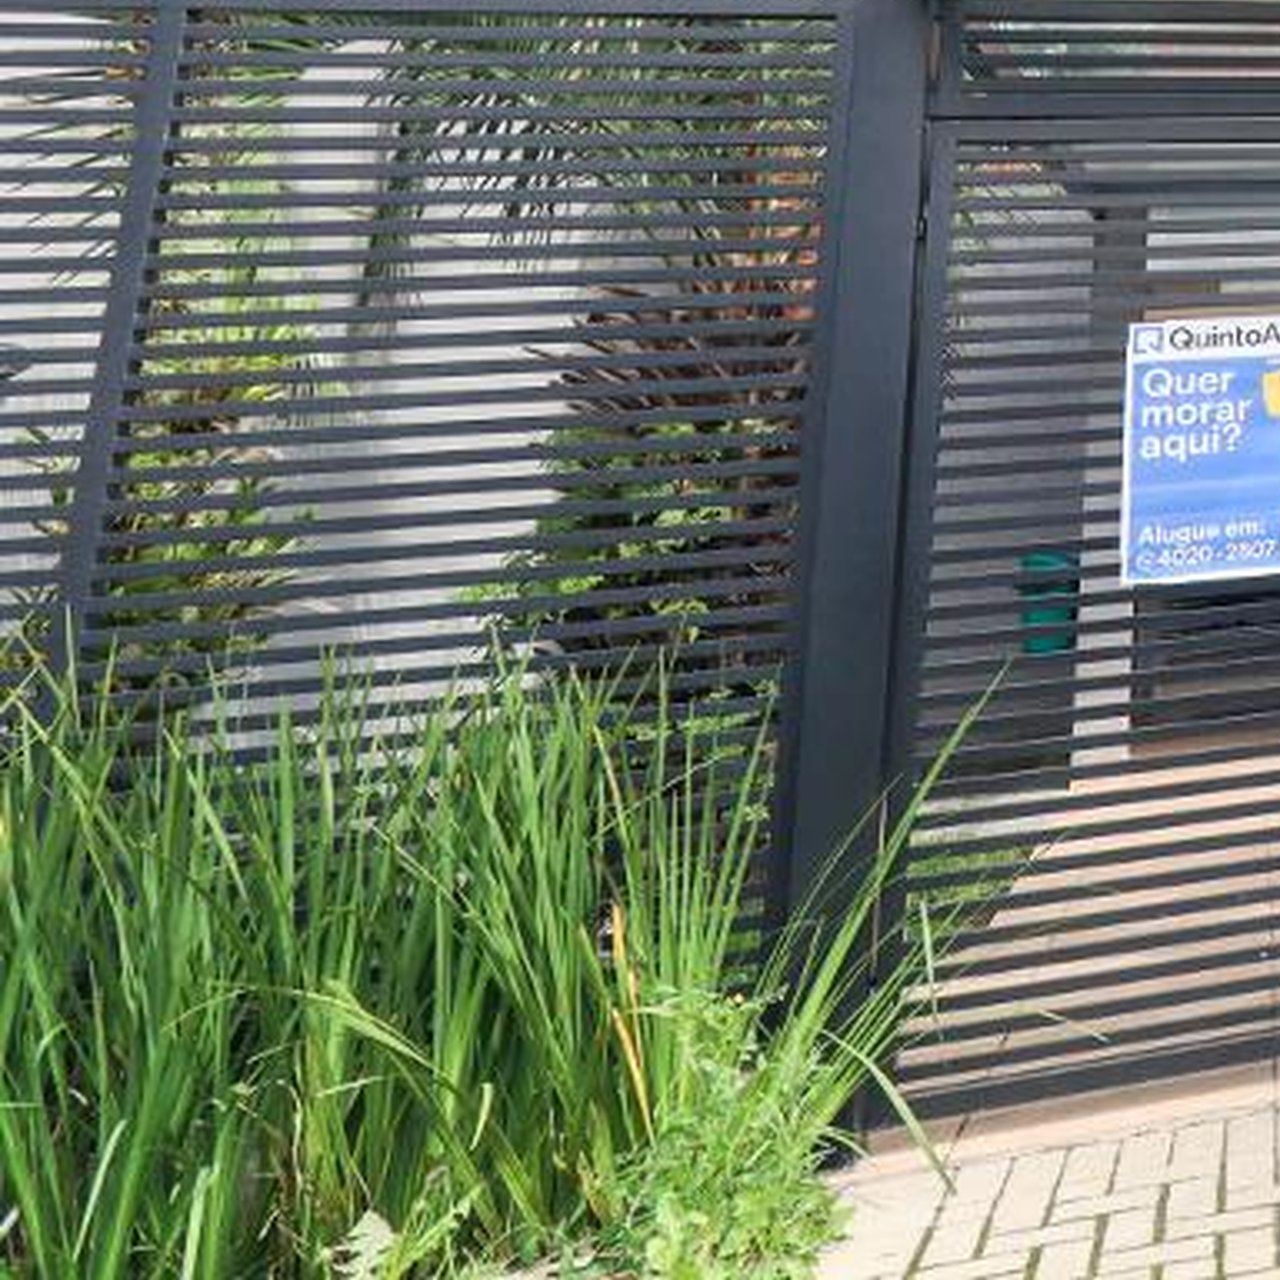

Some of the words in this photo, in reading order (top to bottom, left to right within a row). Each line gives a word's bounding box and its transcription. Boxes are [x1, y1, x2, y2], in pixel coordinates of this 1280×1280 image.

[1142, 368, 1234, 397] Quer
[1140, 399, 1252, 428] morar
[1140, 423, 1242, 463] aqui?
